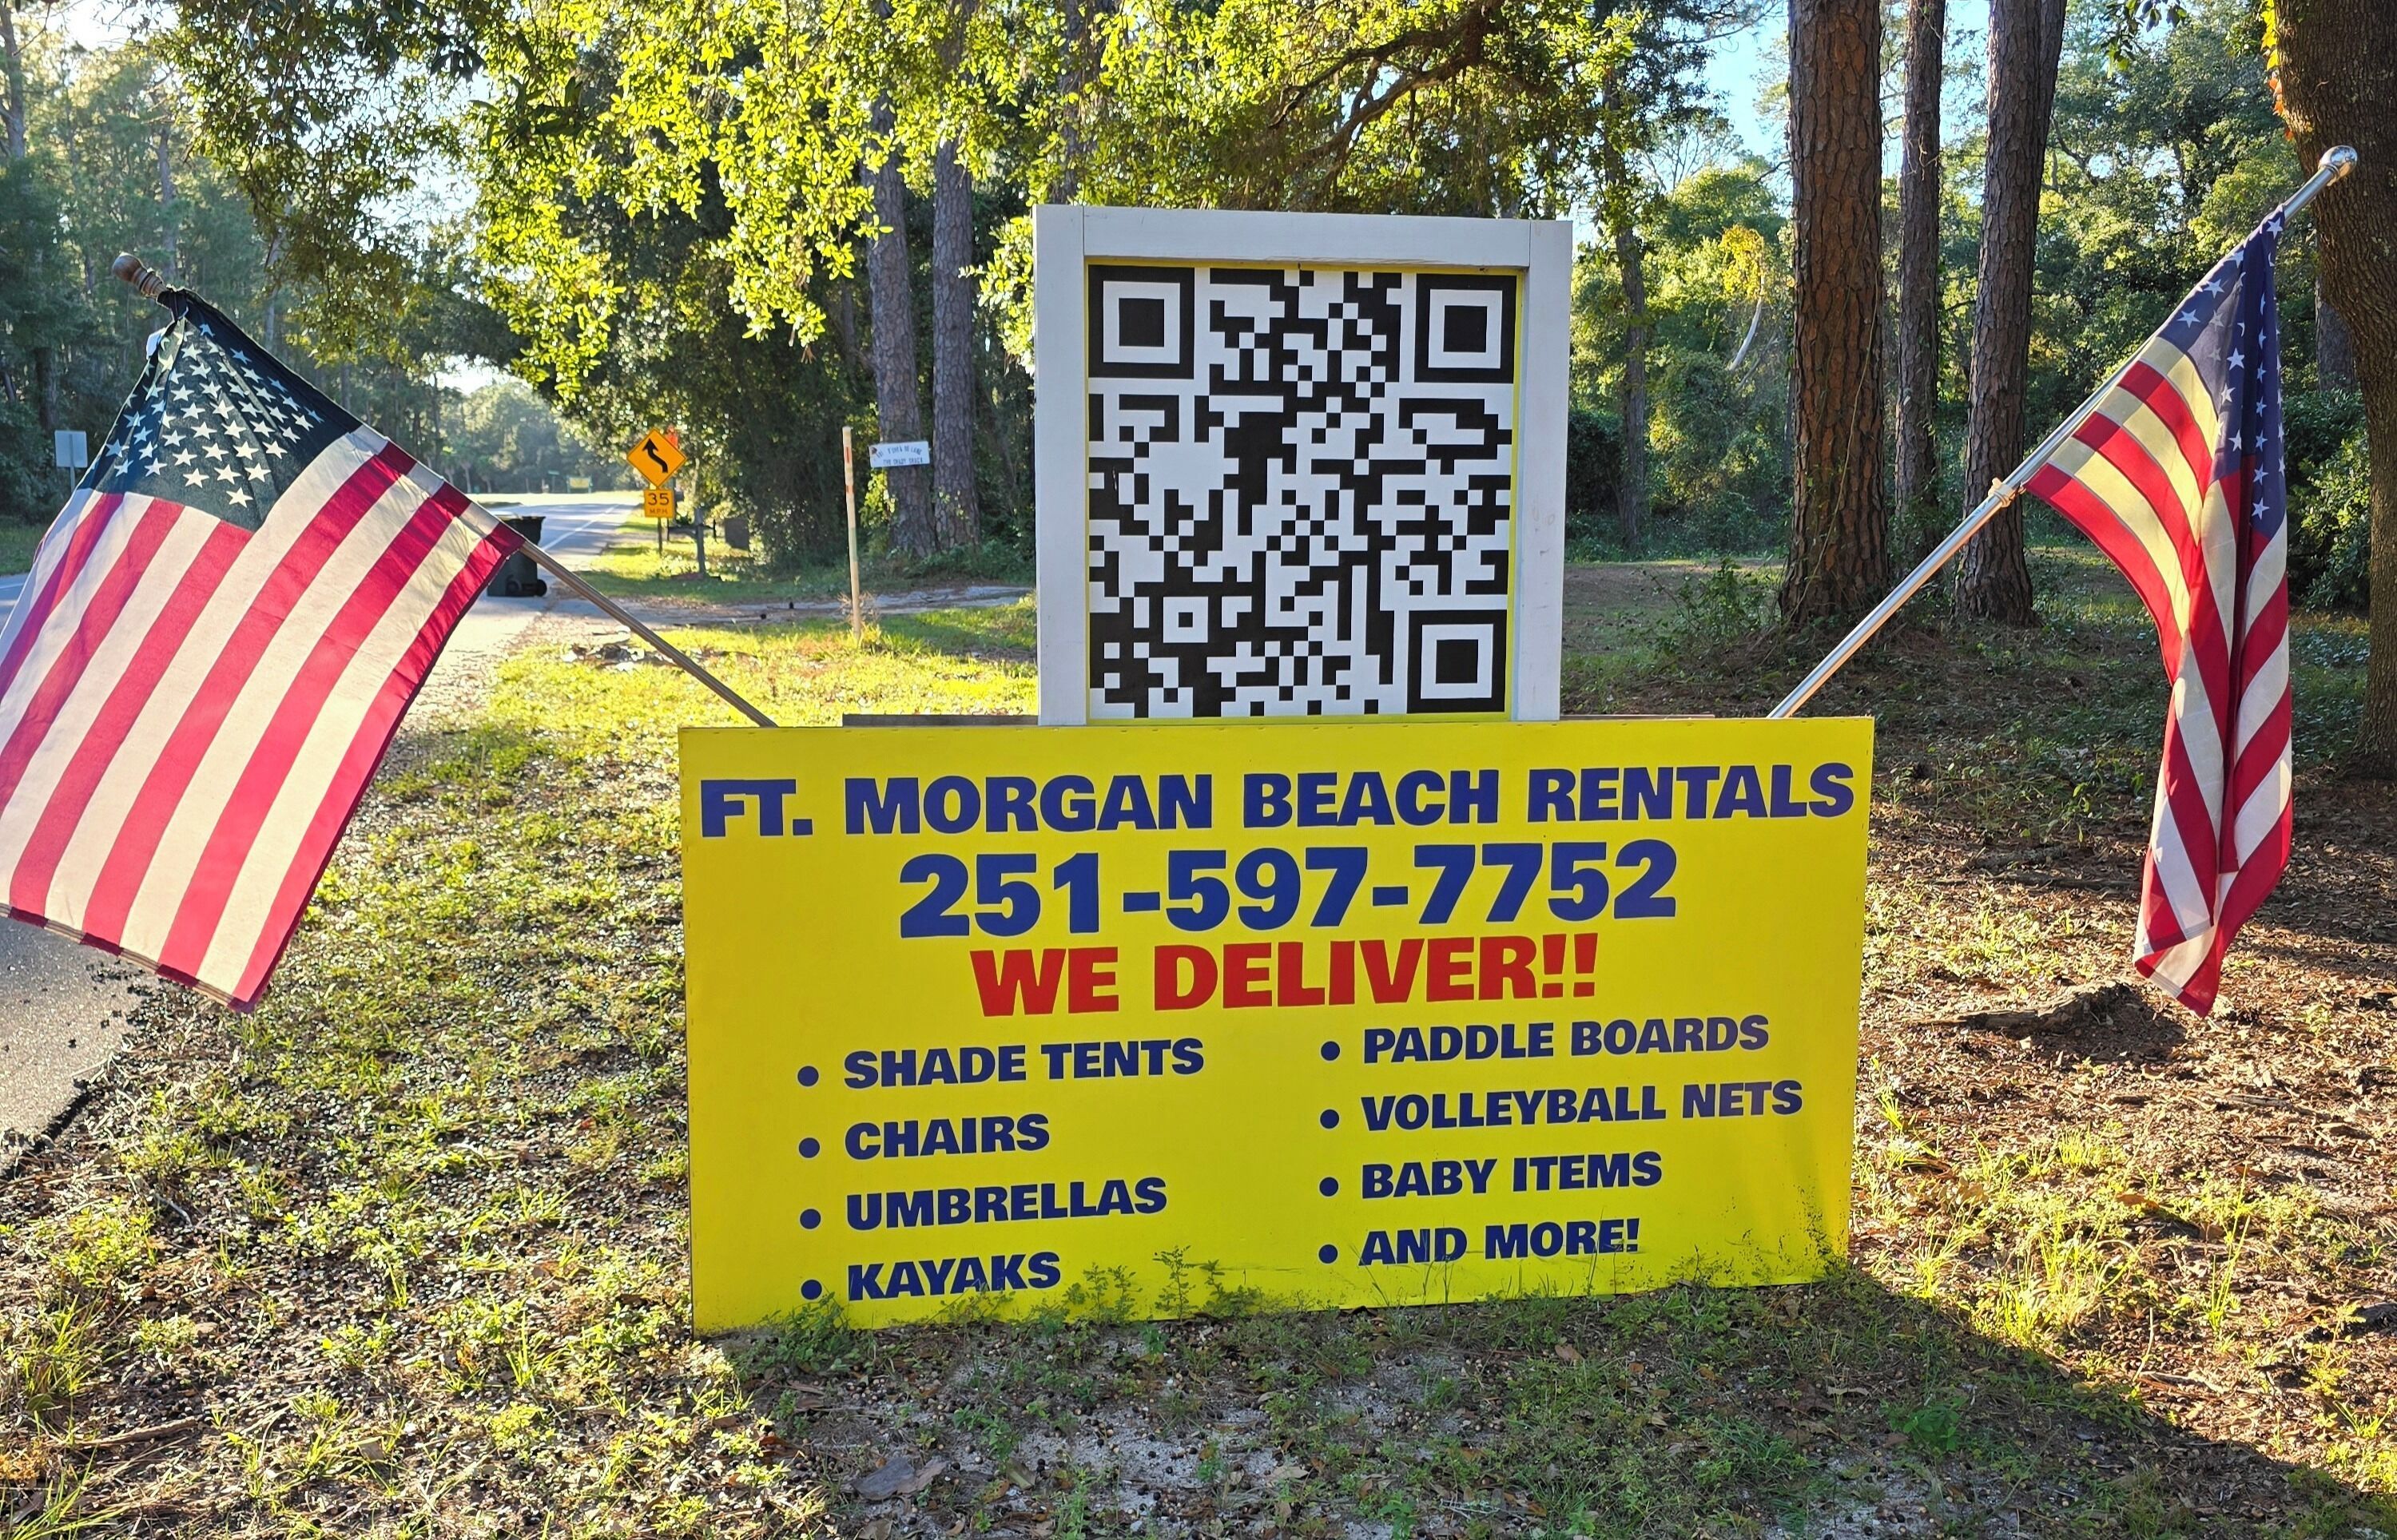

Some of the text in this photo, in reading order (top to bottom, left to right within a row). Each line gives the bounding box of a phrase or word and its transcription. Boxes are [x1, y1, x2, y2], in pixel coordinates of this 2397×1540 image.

[648, 492, 670, 506] 35
[702, 764, 1854, 836] FT. MORGAN BEACH RENTALS
[900, 840, 1676, 938] 251-597-7752
[971, 932, 1598, 1017] WE DELIVER!!
[1365, 1016, 1767, 1062] PADDLE BOARDS
[846, 1039, 1204, 1088] SHADE TENTS
[1363, 1082, 1802, 1131] VOLLEYBALL NETS
[846, 1115, 1050, 1159] CHAIRS
[1362, 1153, 1661, 1198] BABY ITEMS
[848, 1178, 1167, 1229] UMBRELLAS
[1359, 1219, 1640, 1265] AND MORE!
[849, 1252, 1060, 1300] KAYAKS
